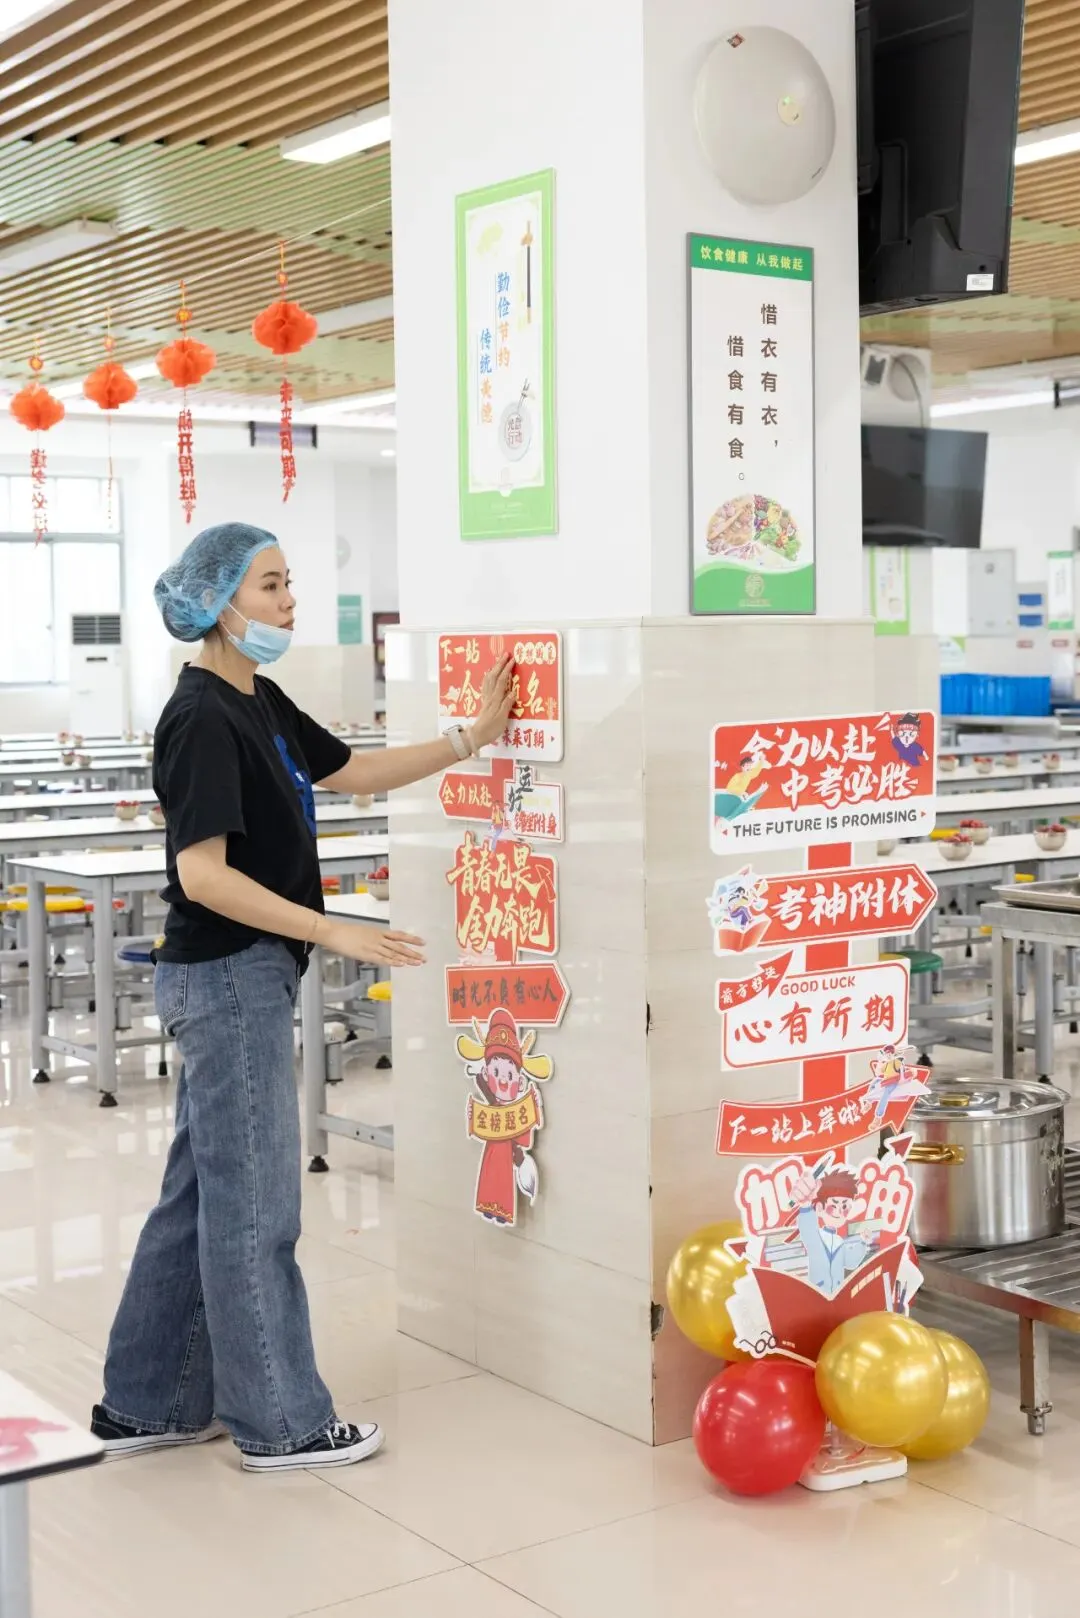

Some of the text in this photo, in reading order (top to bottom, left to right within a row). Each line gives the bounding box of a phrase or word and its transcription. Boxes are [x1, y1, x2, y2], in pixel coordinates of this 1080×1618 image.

[700, 245, 804, 271] 饮食健康 从我做起
[440, 638, 480, 664] 下一站
[502, 727, 545, 748] 未来可期
[740, 723, 877, 770] 全力以赴
[442, 780, 493, 808] 全力以赴
[780, 762, 913, 808] 中考必胜
[733, 809, 917, 838] THE FUTURE IS PROMISING
[452, 976, 557, 1009] 时光不负有心人
[780, 975, 856, 996] GOOD LUCK
[734, 993, 895, 1045] 心有所期
[477, 1106, 528, 1132] 金榜题名
[728, 1098, 861, 1148] 下一站上岸啦
[742, 1161, 911, 1233] 加油
